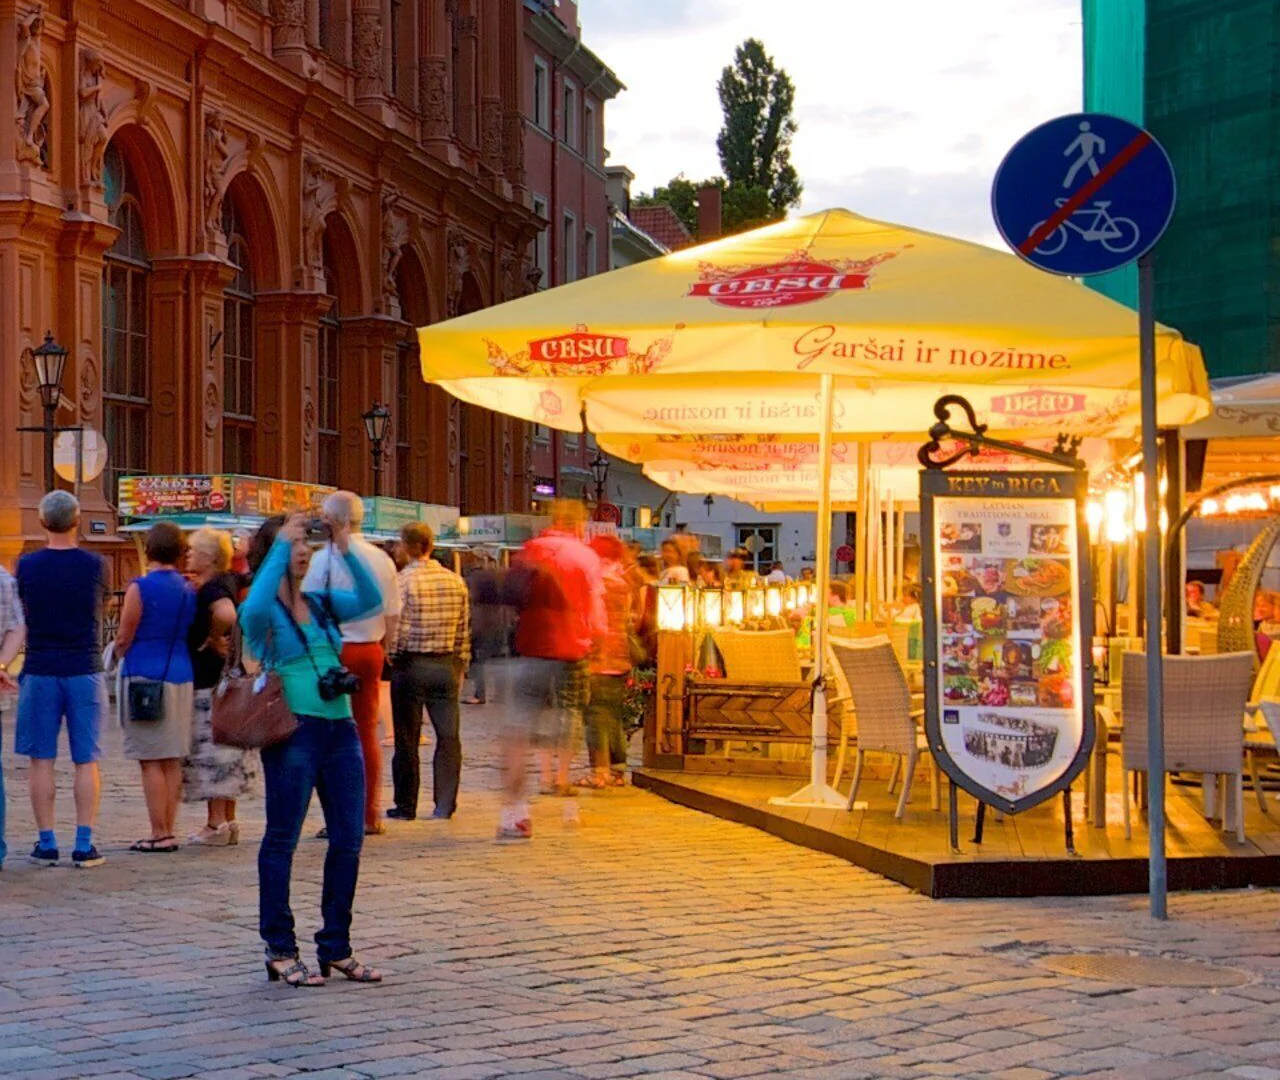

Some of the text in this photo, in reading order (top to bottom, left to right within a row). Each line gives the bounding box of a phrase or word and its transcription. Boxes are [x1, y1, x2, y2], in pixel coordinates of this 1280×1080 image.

[793, 325, 1072, 370] Garšai ir nozīme.
[947, 477, 990, 492] KEY
[1007, 477, 1061, 493] RIGA
